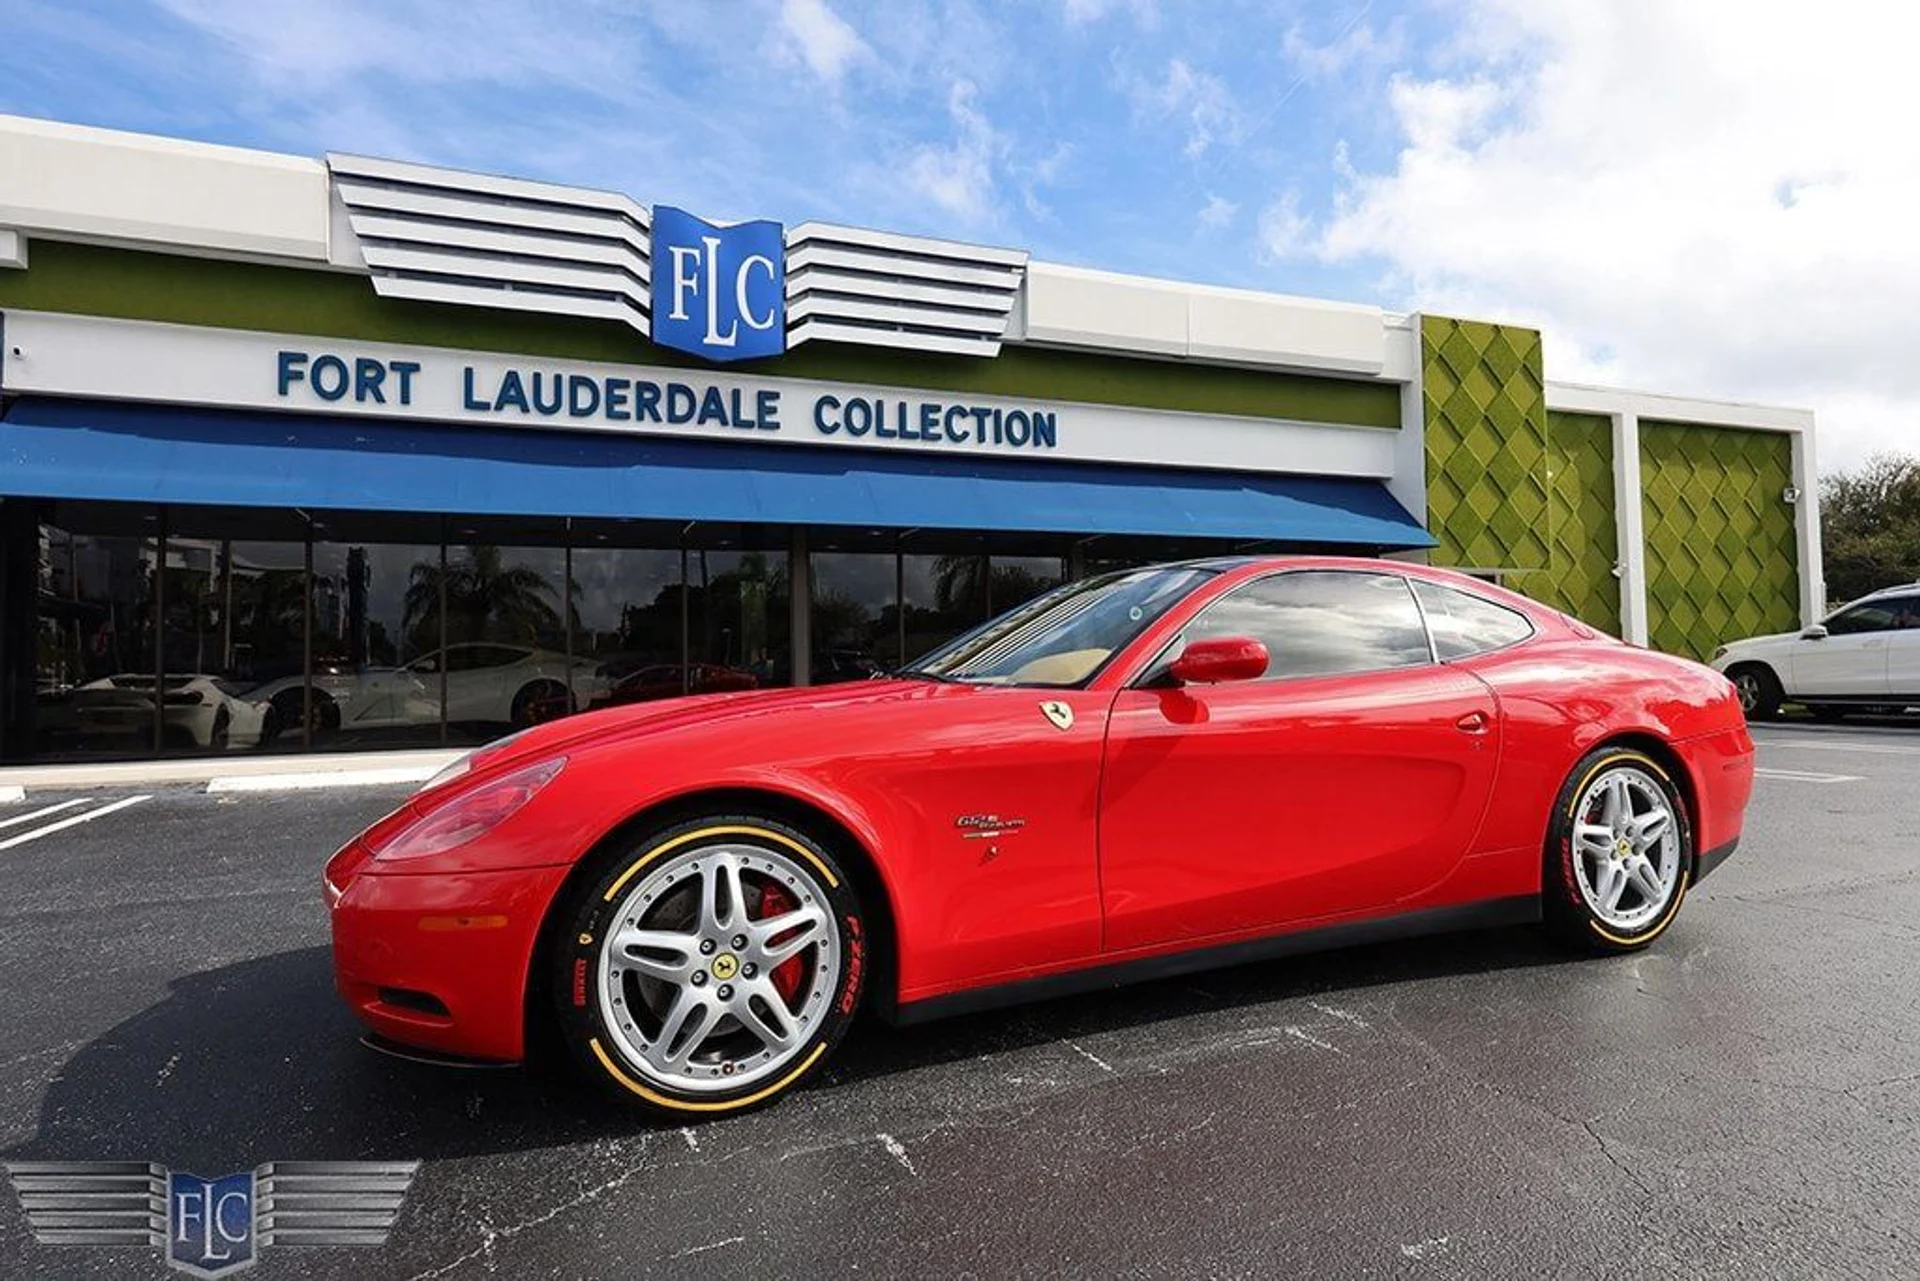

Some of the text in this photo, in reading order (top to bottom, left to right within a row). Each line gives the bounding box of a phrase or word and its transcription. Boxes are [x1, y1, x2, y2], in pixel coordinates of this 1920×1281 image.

[669, 236, 775, 347] FLC
[278, 350, 1056, 447] FORT LAUDERDALE COLLECTION
